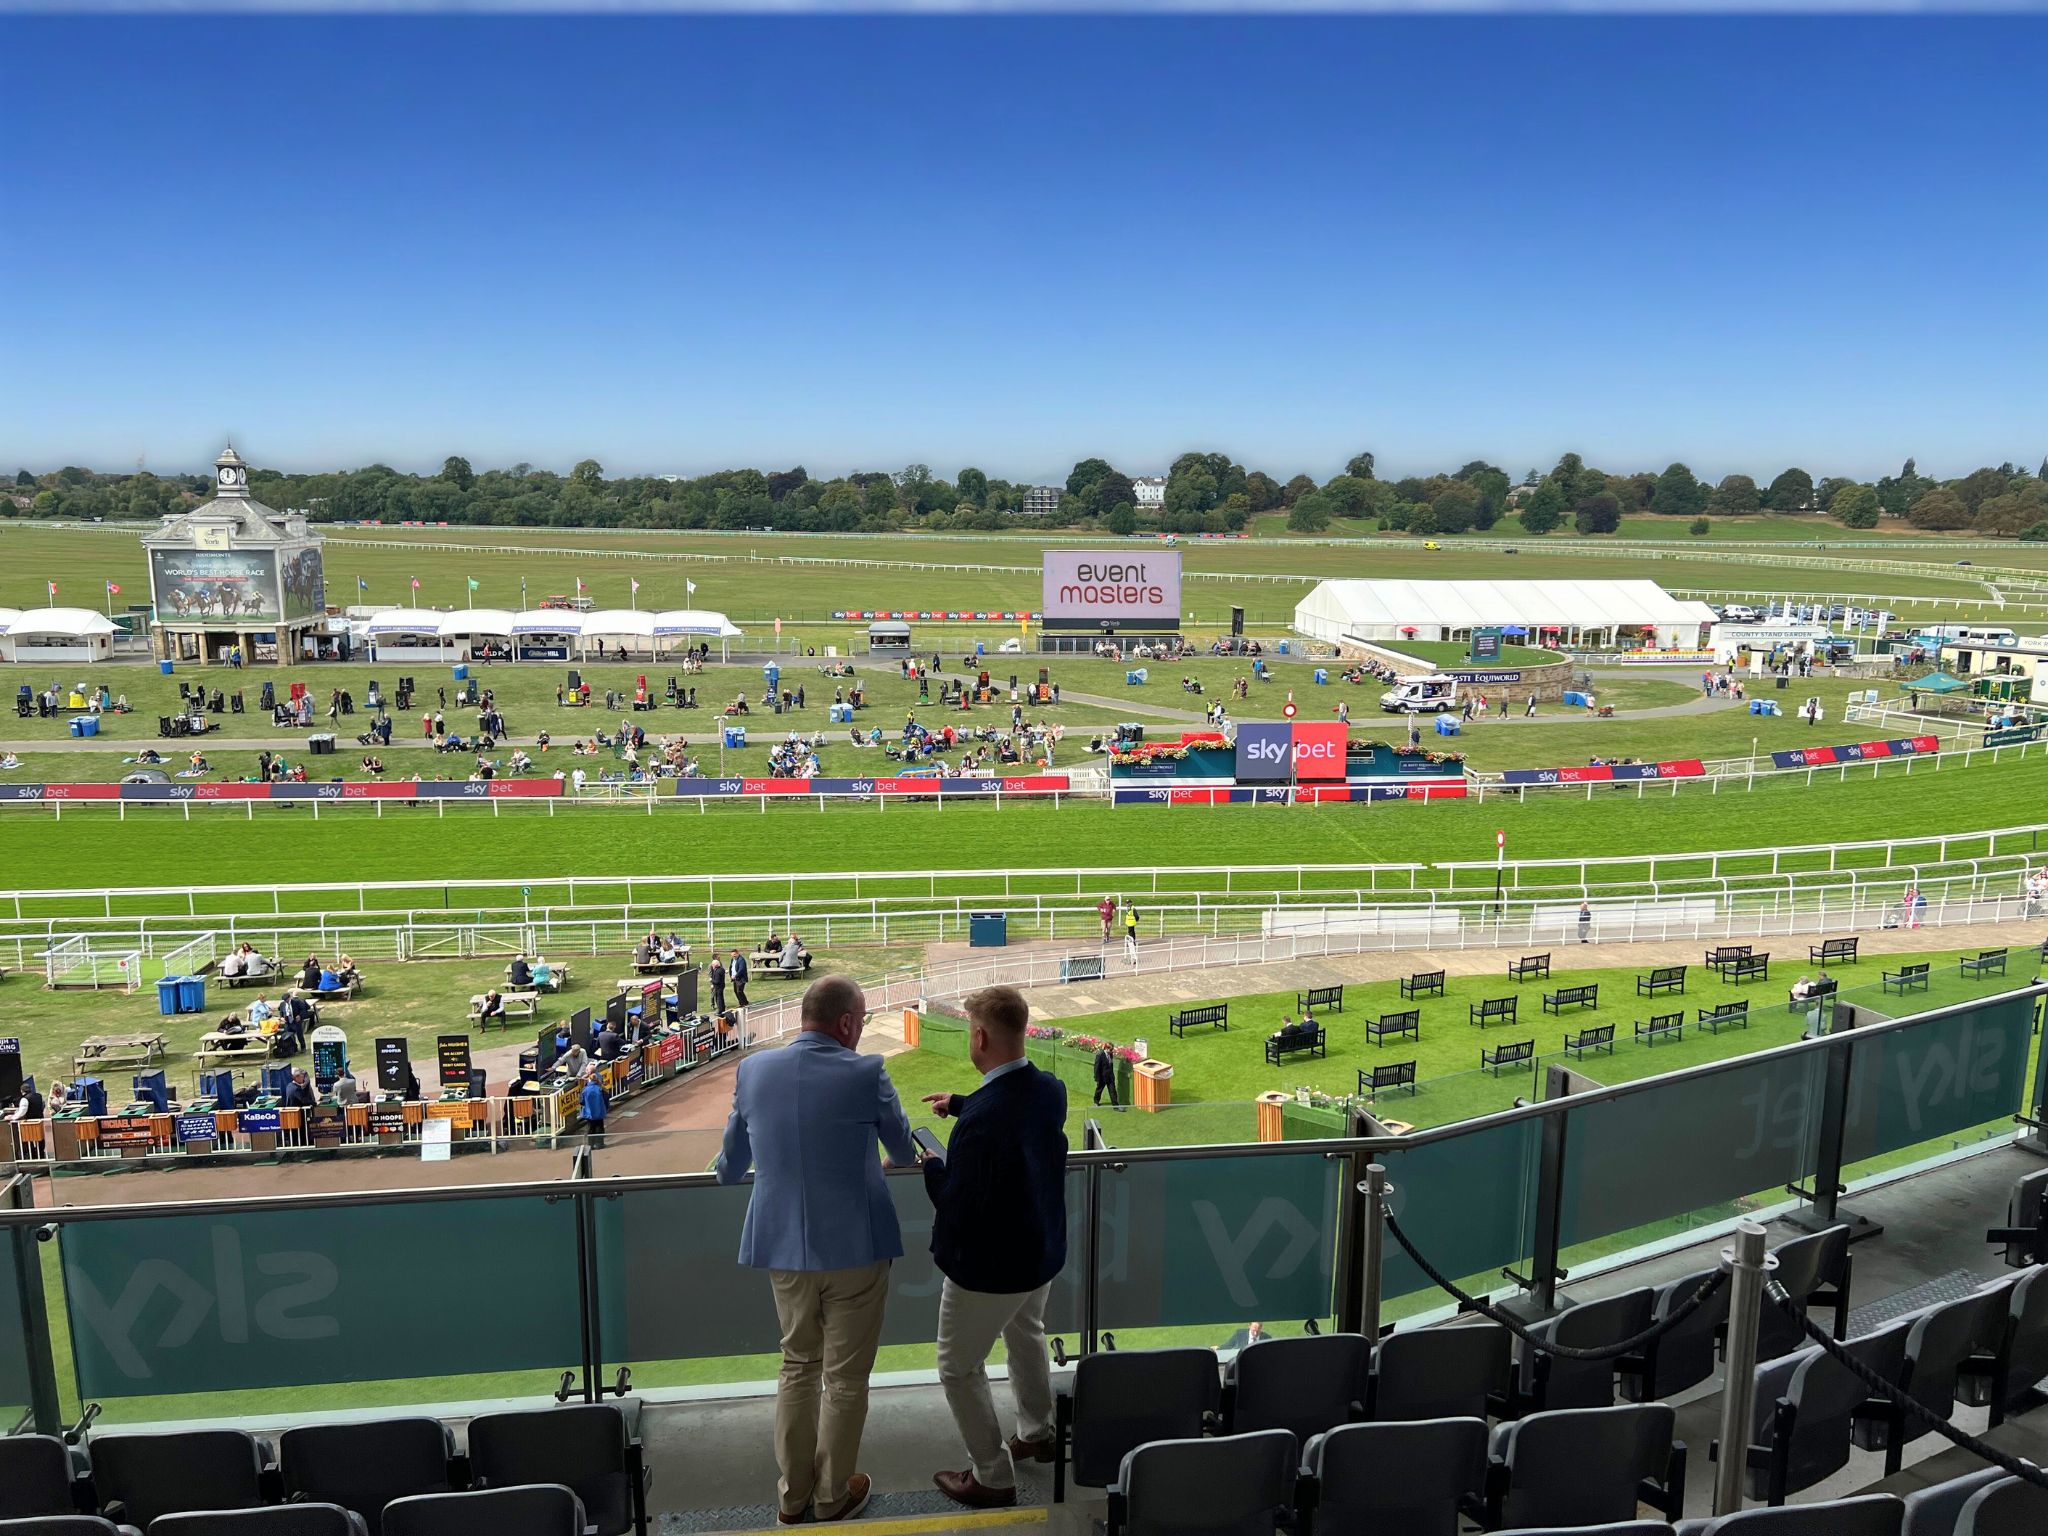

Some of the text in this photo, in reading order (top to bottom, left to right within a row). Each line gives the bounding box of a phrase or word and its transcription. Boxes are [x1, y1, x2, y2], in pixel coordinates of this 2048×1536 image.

[1078, 564, 1146, 582] event
[1060, 584, 1163, 604] masters
[1475, 674, 1519, 682] EQUIWORLD
[1247, 738, 1335, 763] sky bet
[1848, 745, 1875, 756] sky bet
[1901, 738, 1925, 751] sky bet
[1790, 751, 1819, 764] sky bet
[1538, 771, 1580, 782] sky bet
[1642, 764, 1676, 777] sky bet
[464, 782, 512, 794] sky bet
[720, 780, 766, 792] sky bet
[852, 780, 898, 792] sky bet
[982, 780, 1025, 791] sky bet
[1386, 784, 1424, 796] sky be
[18, 786, 69, 799] sky bet
[170, 786, 219, 798] sky bet
[318, 786, 367, 798] sky bet
[1149, 788, 1192, 800] sky bet
[1266, 786, 1286, 798] sky
[561, 1088, 580, 1106] KEITH
